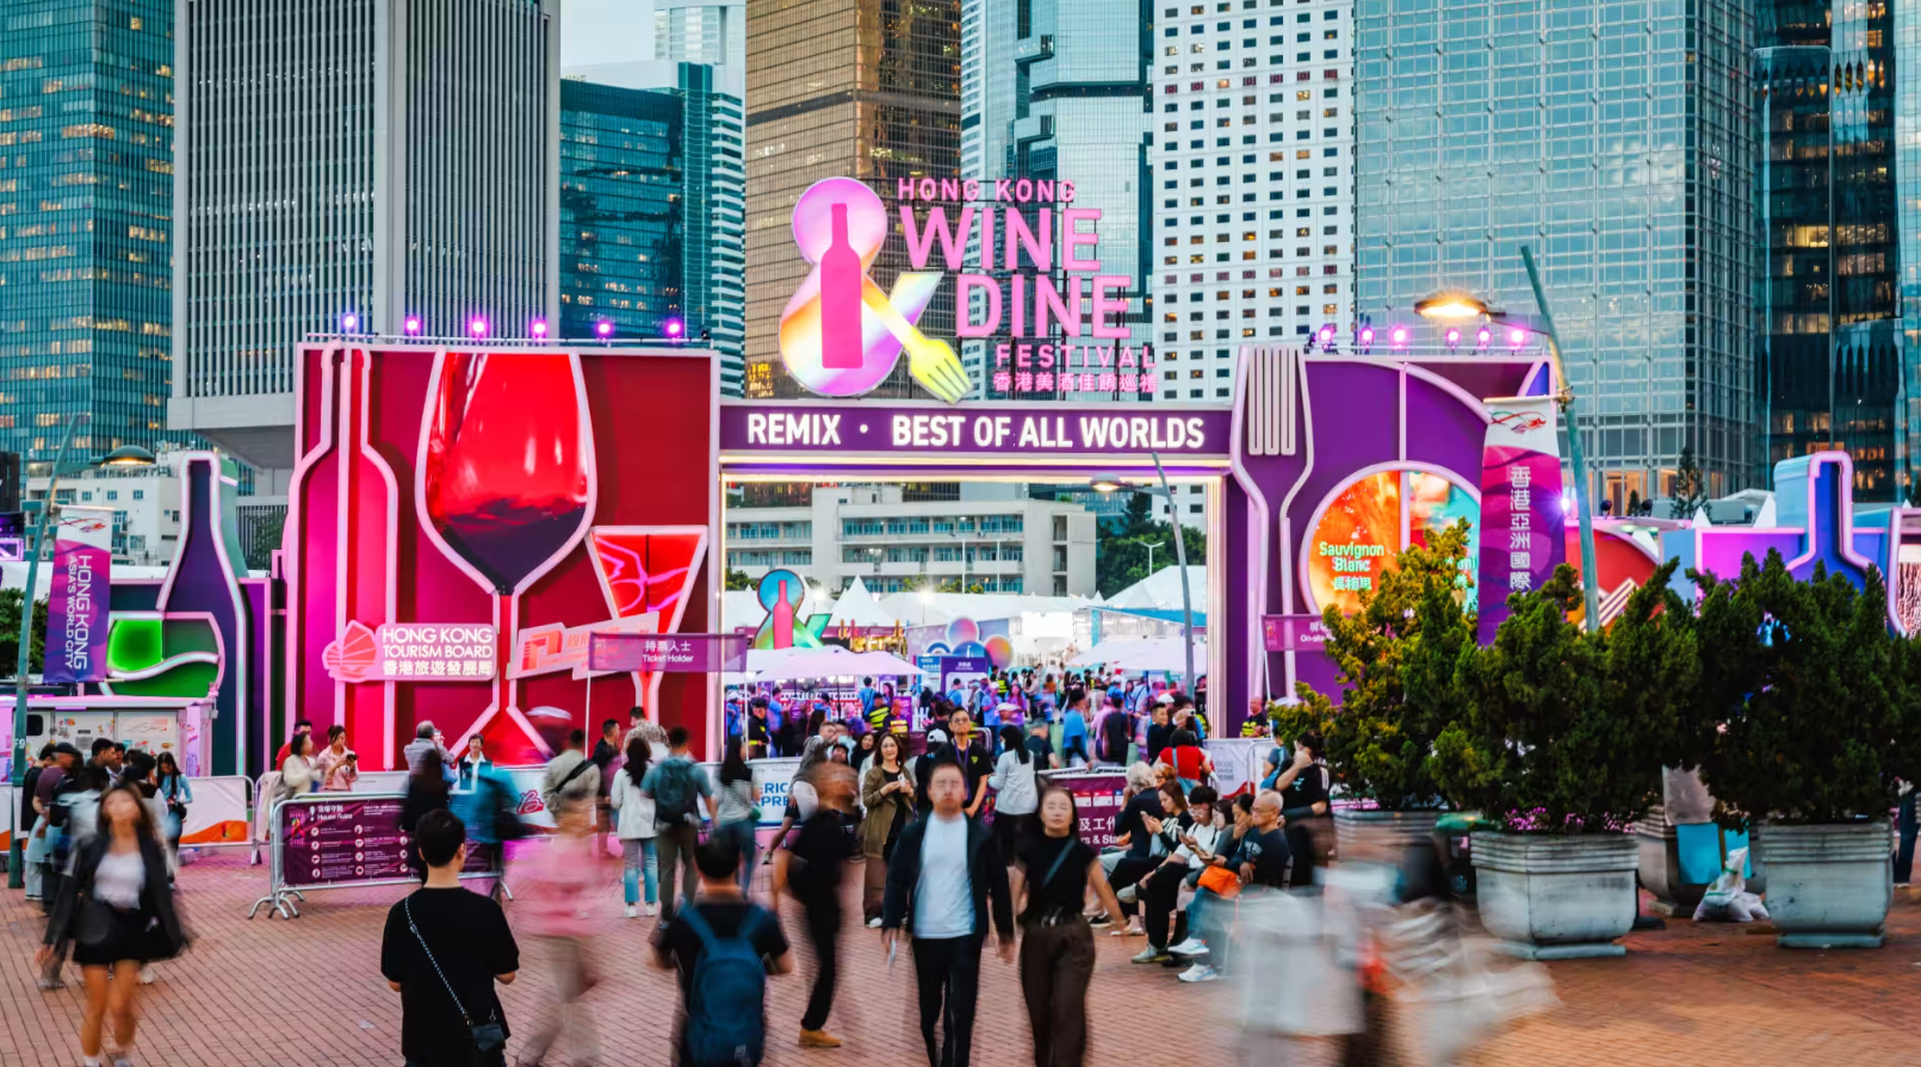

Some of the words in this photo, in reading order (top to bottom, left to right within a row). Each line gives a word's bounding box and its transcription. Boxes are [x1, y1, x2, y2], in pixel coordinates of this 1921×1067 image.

[898, 177, 980, 202] HONG
[995, 178, 1076, 203] KONG
[899, 205, 1102, 272] WINE
[956, 274, 1132, 339] DINE
[996, 344, 1157, 369] FESTIVAL
[993, 371, 1158, 393] 香港美酒佳餚巡禮
[747, 413, 842, 446] REMIX
[892, 414, 966, 447] BEST
[974, 416, 1011, 447] OF
[1019, 417, 1073, 448] ALL
[1080, 417, 1206, 449] WORLDS
[1510, 466, 1531, 591] 香港亞洲國際
[1319, 541, 1384, 559] Sauvignon
[67, 555, 77, 594] ASIA'S
[1334, 556, 1371, 572] Blanc
[76, 555, 92, 612] HONG
[65, 596, 76, 638] WORLD
[73, 614, 90, 670] KONG
[382, 627, 437, 644] HONG
[440, 627, 493, 644] KONG
[644, 640, 692, 653] 持票人士
[64, 640, 73, 670] CITY
[383, 645, 443, 658] TOURISM
[445, 645, 493, 658] BOARD
[642, 654, 666, 663] Ticket
[667, 654, 694, 663] Holder
[383, 660, 493, 676] 香港旅遊發展局
[764, 782, 789, 793] RIC
[1092, 835, 1101, 844] &
